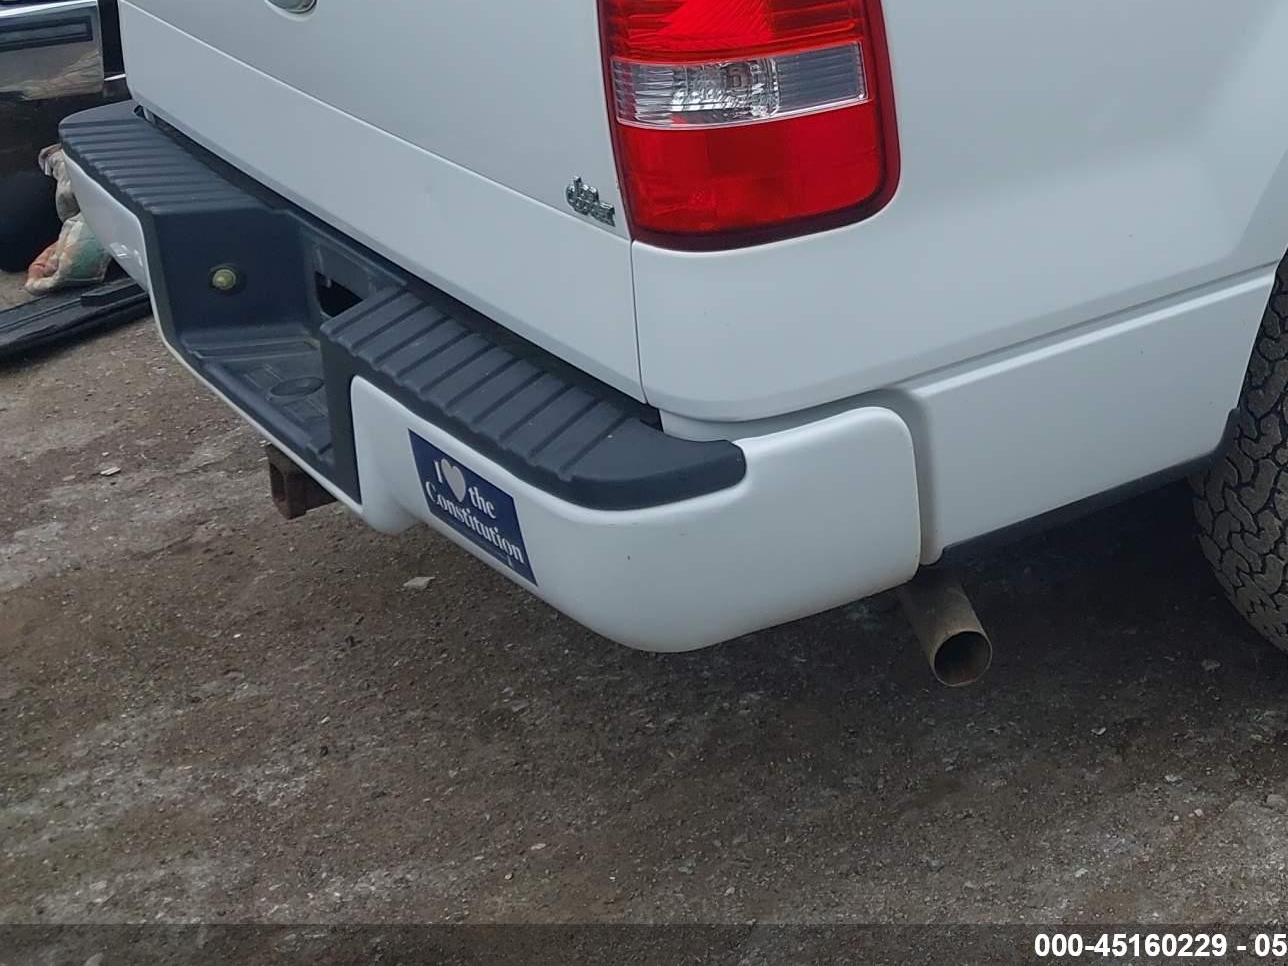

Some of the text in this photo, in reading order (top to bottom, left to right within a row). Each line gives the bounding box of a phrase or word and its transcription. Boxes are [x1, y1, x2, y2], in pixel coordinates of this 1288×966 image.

[425, 481, 526, 565] Constitution
[434, 460, 497, 520] I the
